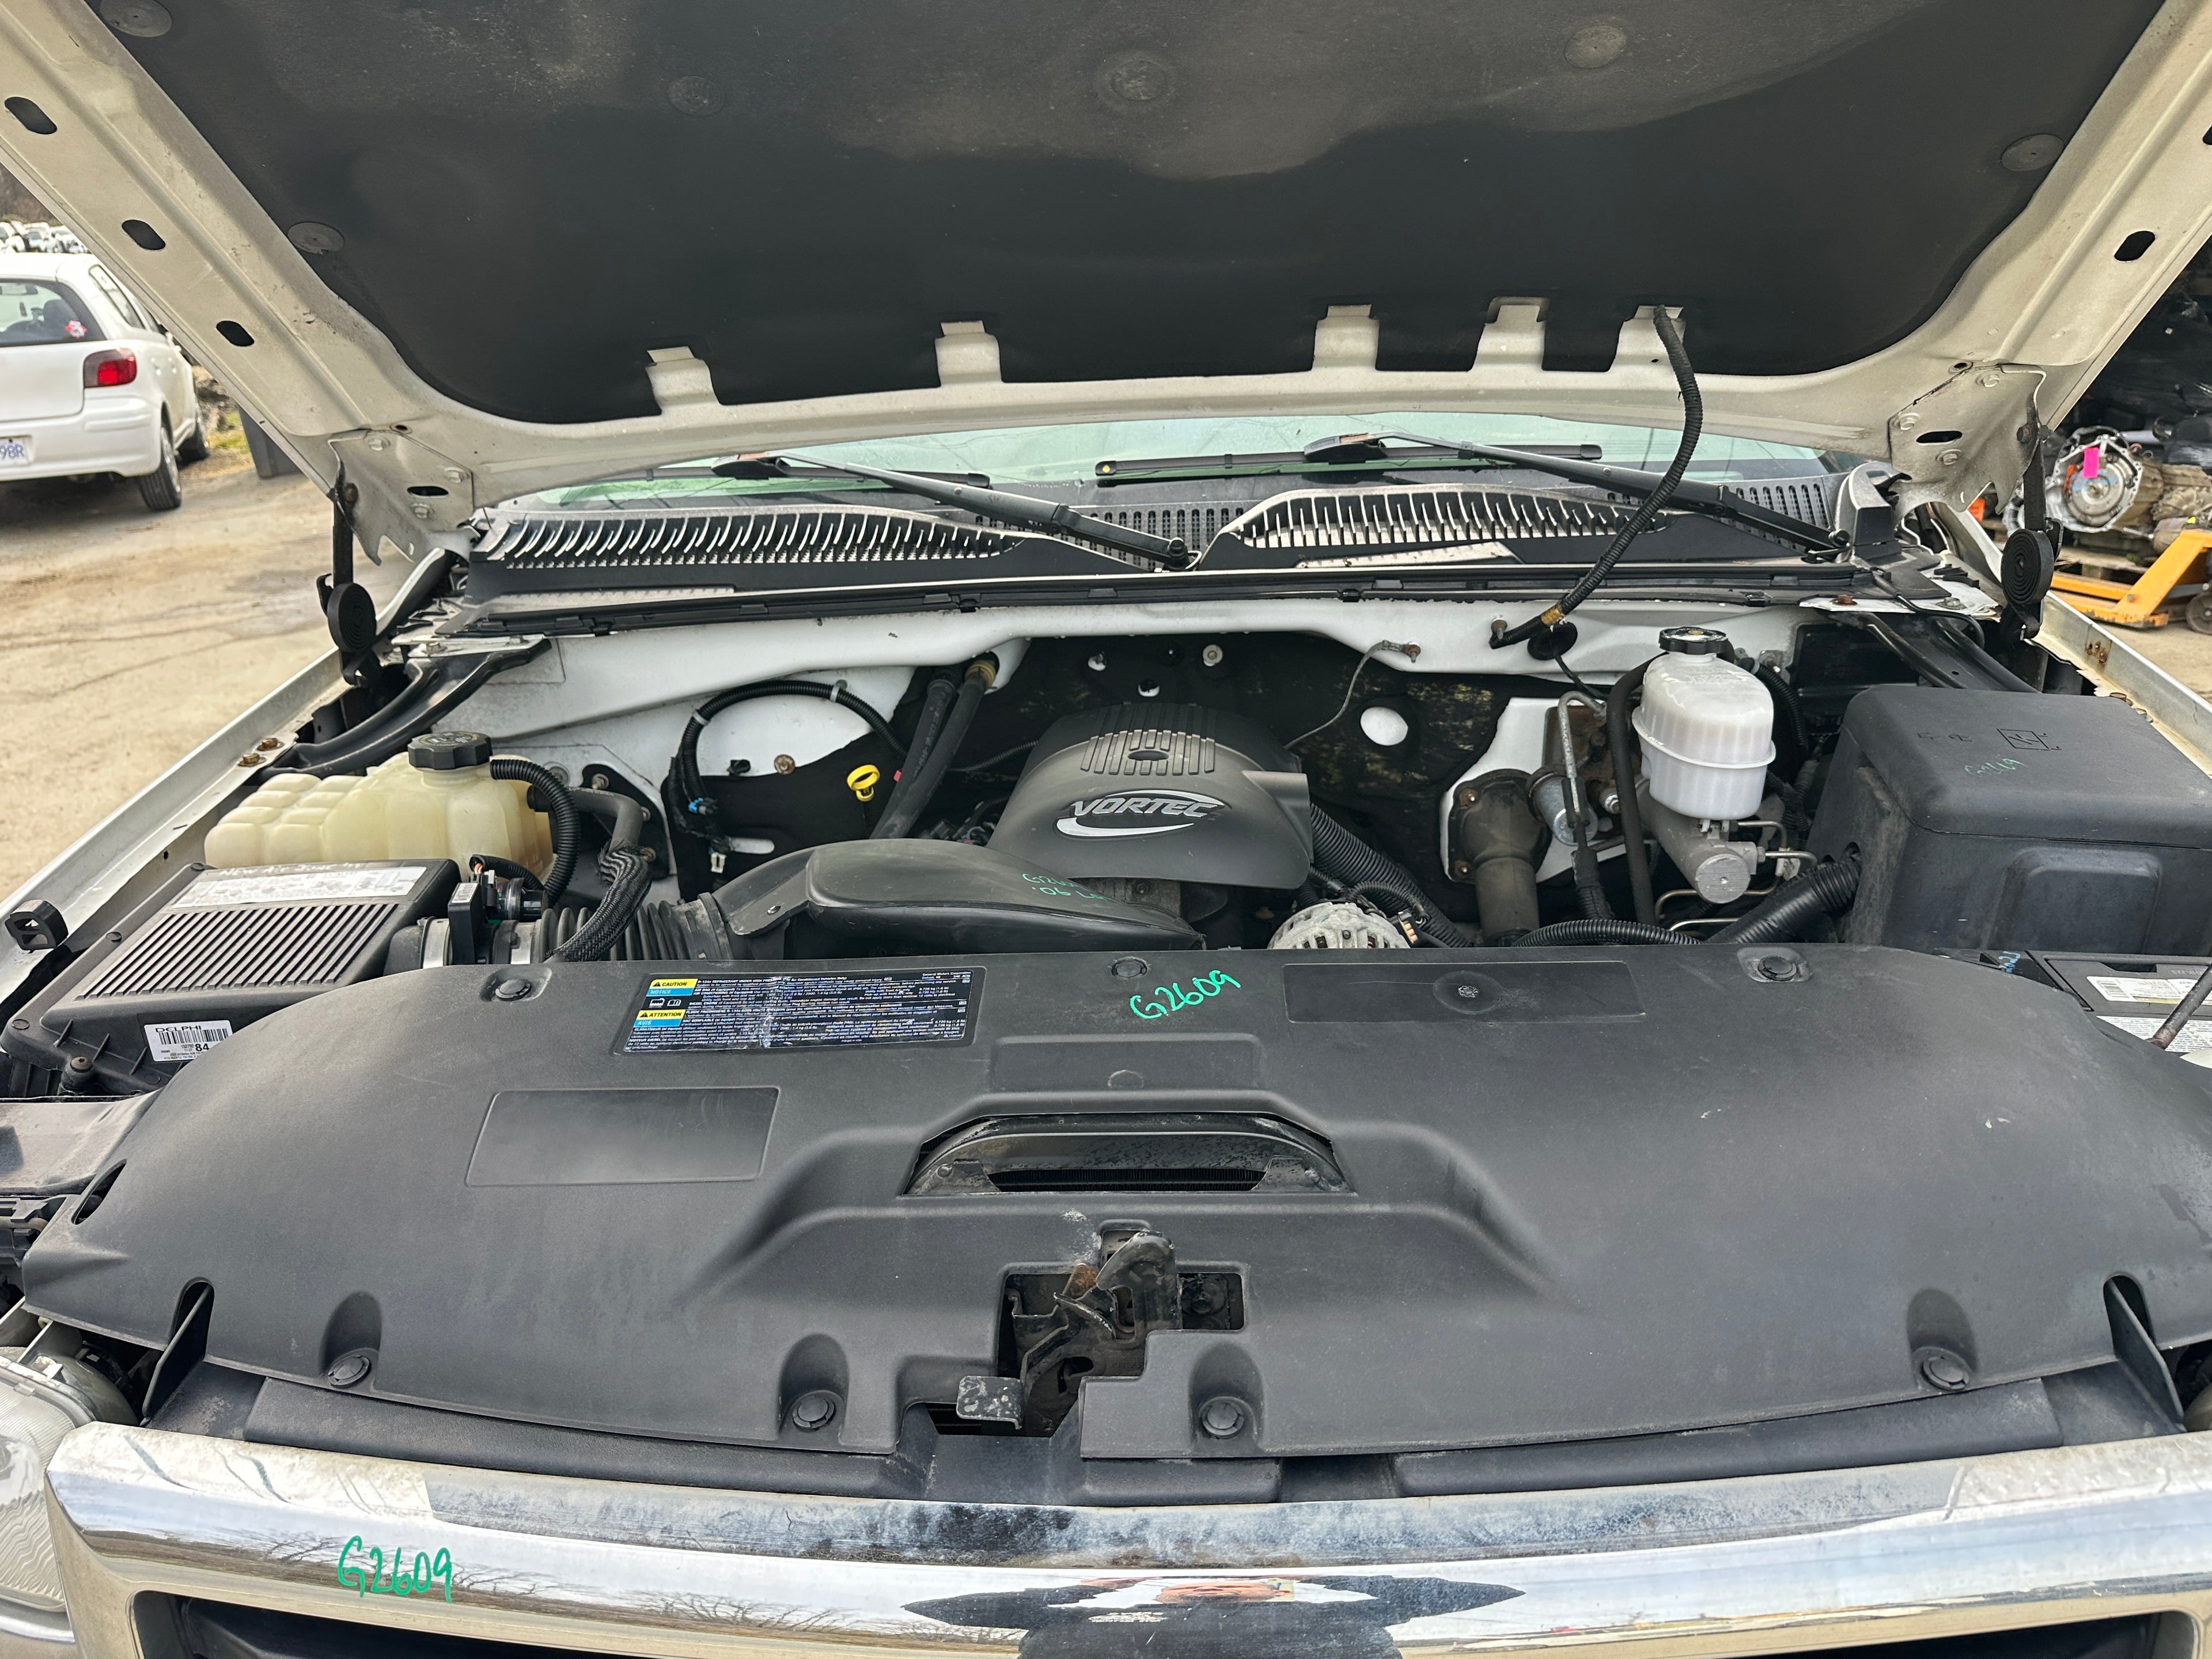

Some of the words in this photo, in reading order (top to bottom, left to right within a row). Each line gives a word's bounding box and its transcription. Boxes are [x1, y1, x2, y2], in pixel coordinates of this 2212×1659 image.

[1070, 797, 1218, 817] VORTEC
[1130, 969, 1241, 1019] G2609
[195, 1043, 210, 1052] 84
[338, 1535, 452, 1603] G2609
